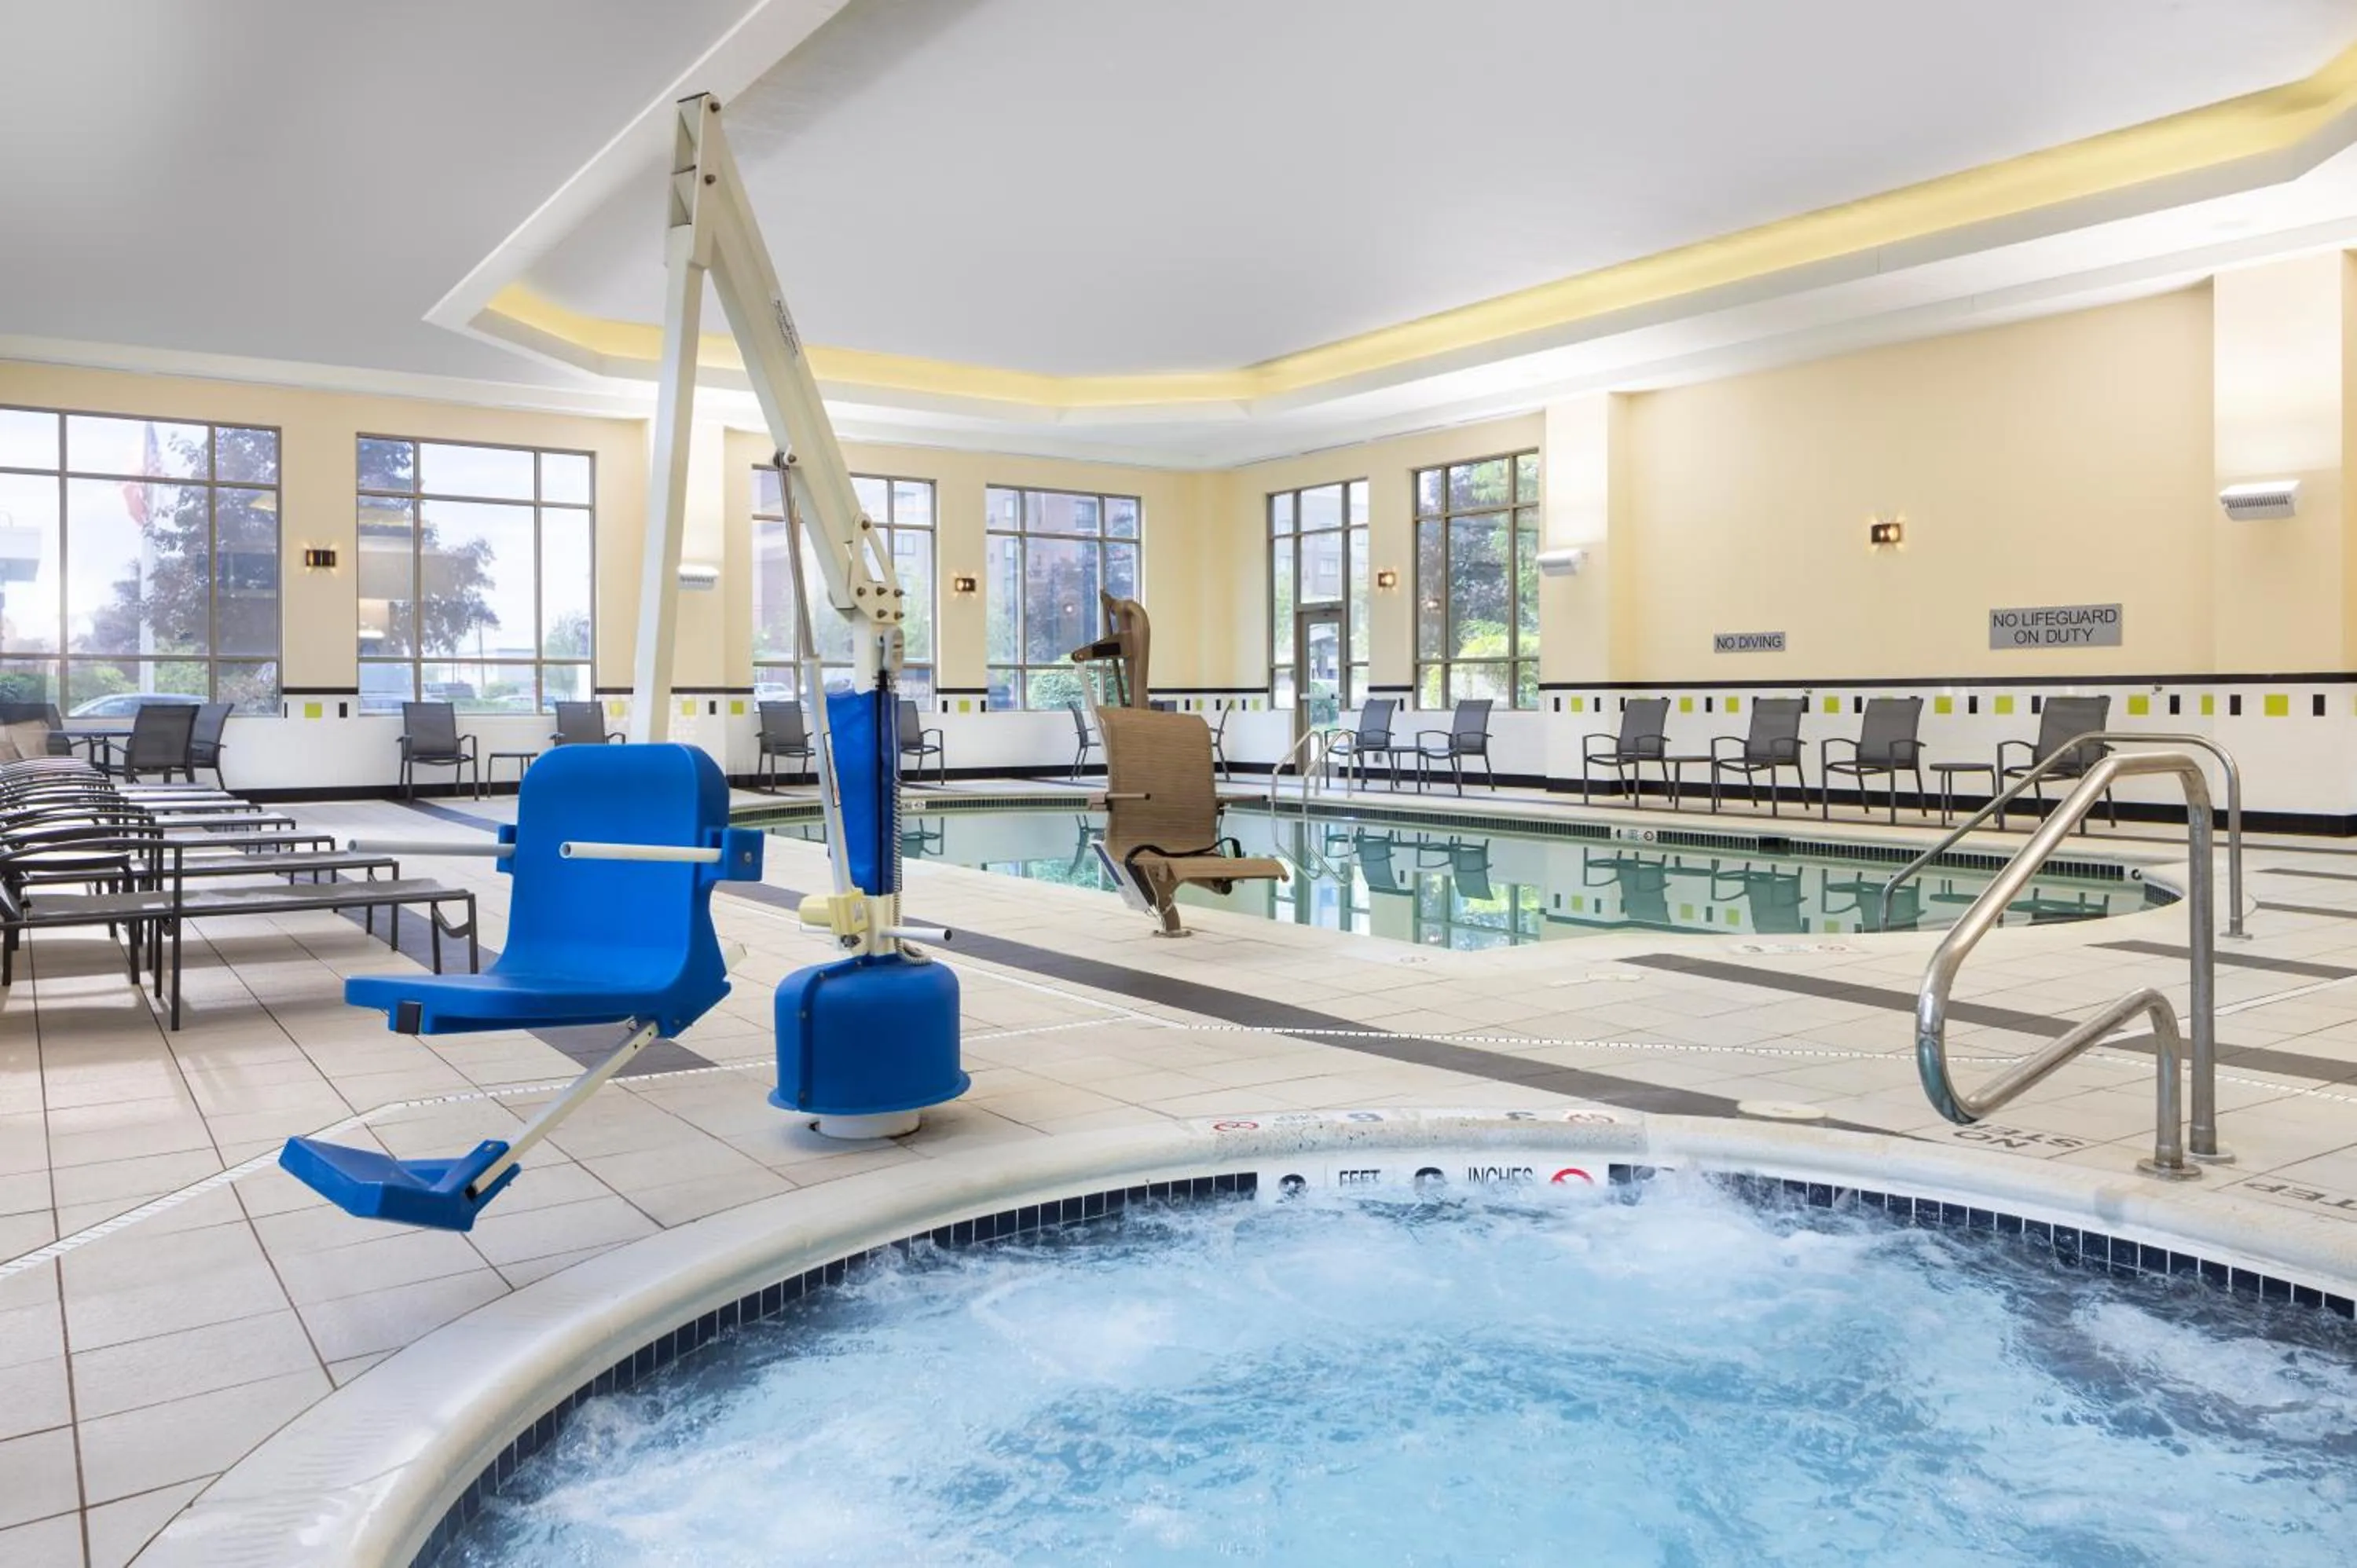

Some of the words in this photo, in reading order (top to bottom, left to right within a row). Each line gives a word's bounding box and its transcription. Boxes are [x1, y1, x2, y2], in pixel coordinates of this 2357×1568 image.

[1993, 613, 2018, 628] NO
[2022, 609, 2117, 627] LIFEGUARD
[1717, 636, 1736, 649] NO
[1738, 635, 1783, 648] DIVING
[2014, 629, 2040, 644] ON
[2046, 628, 2094, 643] DUTY
[1953, 1131, 2030, 1148] NO
